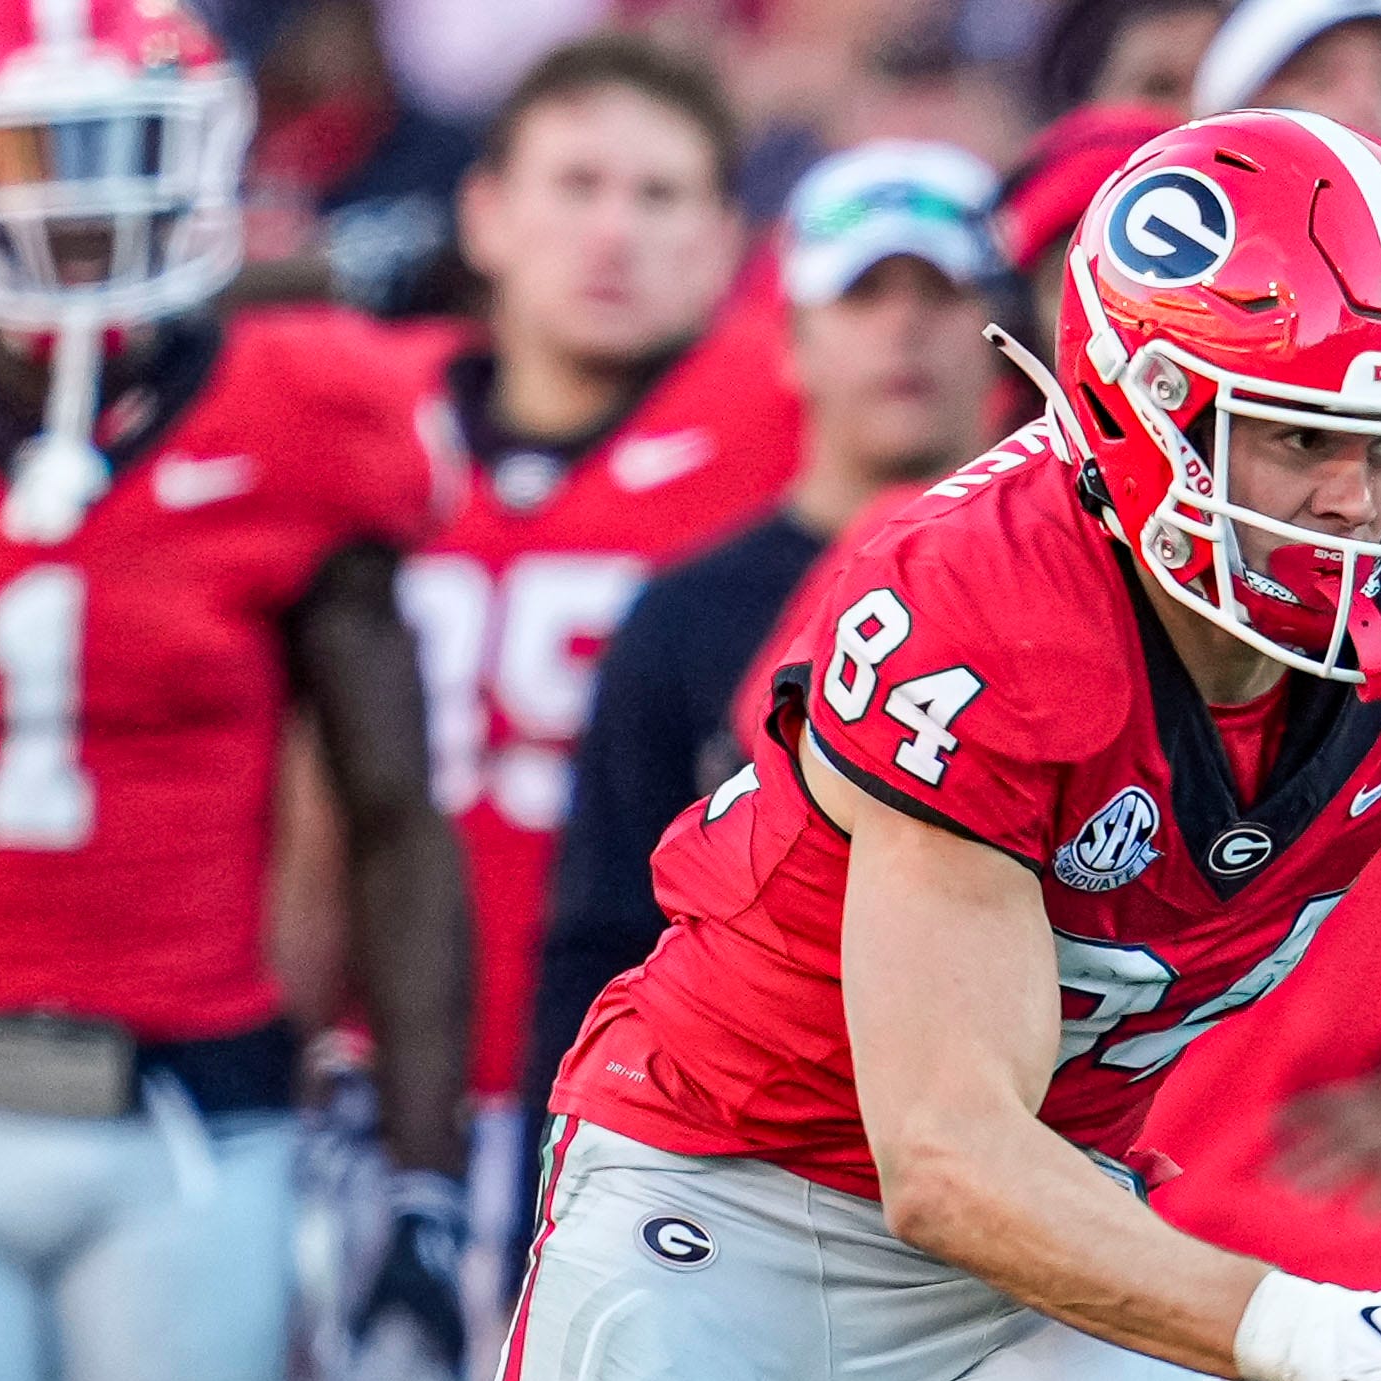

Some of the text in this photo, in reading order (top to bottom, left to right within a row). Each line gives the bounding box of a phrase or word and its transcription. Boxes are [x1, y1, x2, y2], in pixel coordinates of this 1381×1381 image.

[1106, 171, 1229, 282] G
[1313, 548, 1344, 562] SHO
[823, 587, 987, 788] 84
[1078, 792, 1154, 871] SEC
[1213, 830, 1271, 872] G
[1055, 856, 1137, 890] GRADUATE
[605, 1060, 647, 1083] DRI-FIT
[641, 1217, 714, 1263] G
